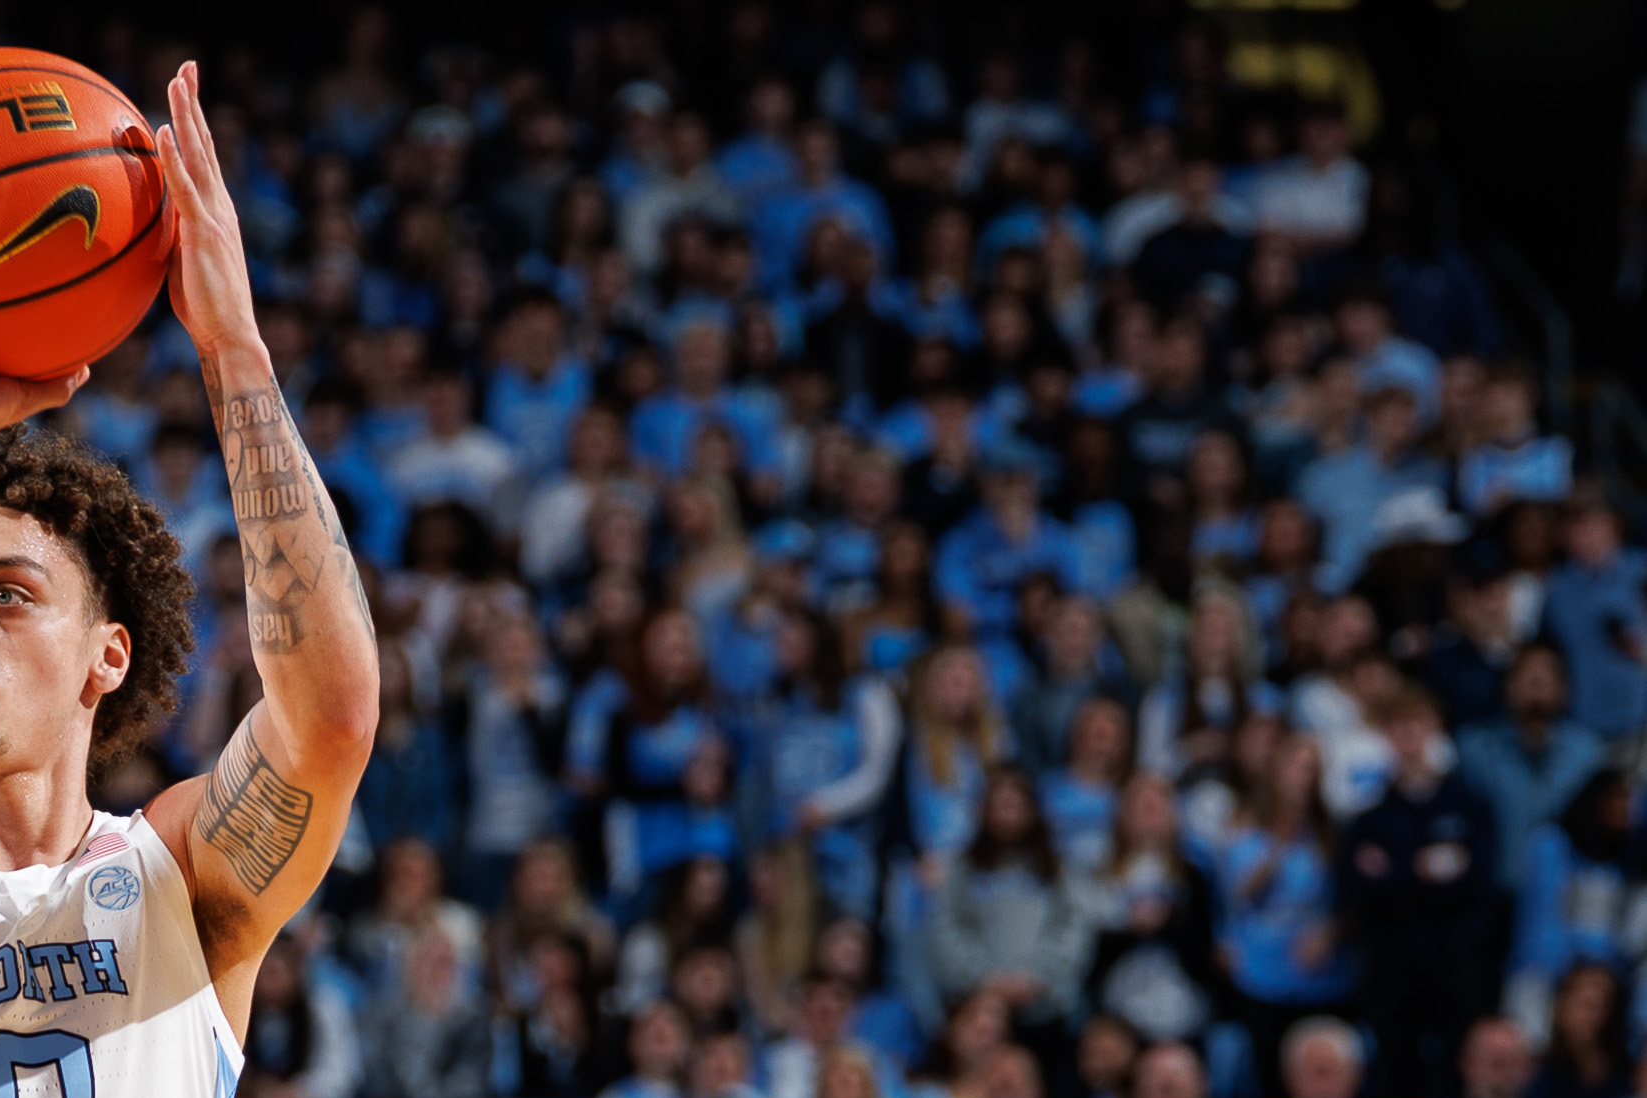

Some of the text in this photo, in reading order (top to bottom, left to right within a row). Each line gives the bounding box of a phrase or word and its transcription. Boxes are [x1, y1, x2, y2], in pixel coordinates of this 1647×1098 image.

[244, 442, 293, 482] and
[234, 481, 308, 522] moun
[252, 611, 294, 648] has
[95, 875, 134, 899] ACC
